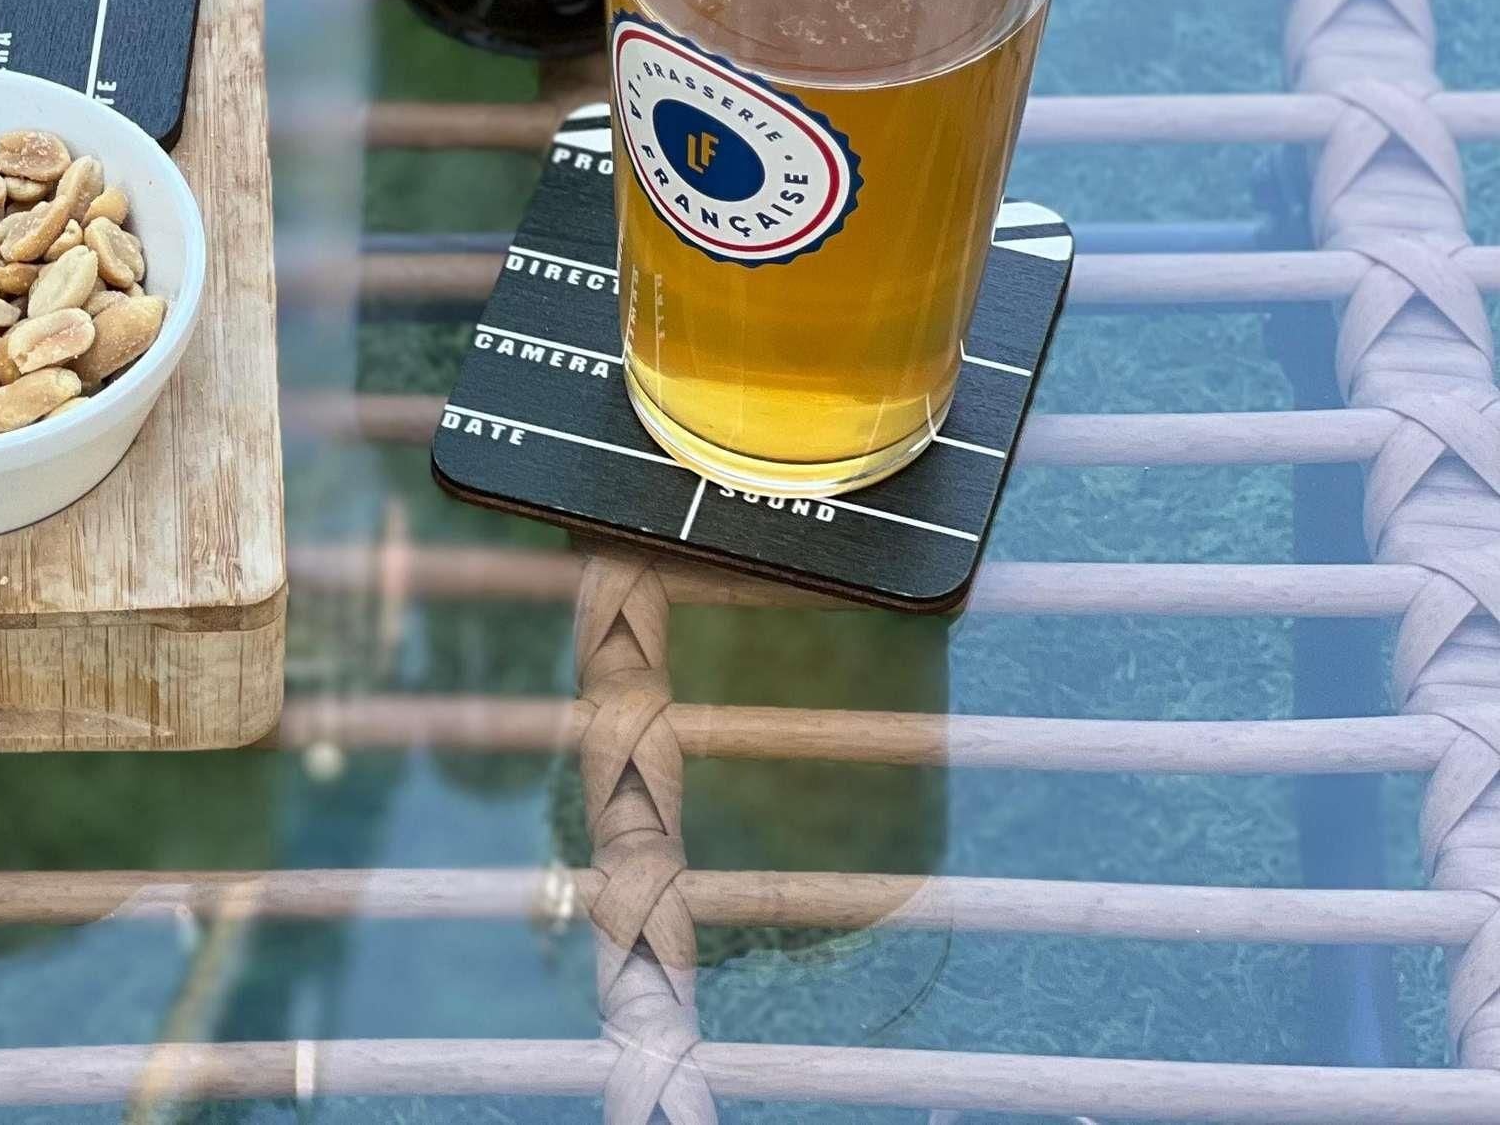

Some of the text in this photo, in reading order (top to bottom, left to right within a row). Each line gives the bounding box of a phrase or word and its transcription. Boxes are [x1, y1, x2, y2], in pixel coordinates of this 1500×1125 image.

[642, 61, 782, 143] BRASSERIE
[627, 79, 809, 238] LA FRANÇAISE
[686, 131, 719, 173] LF
[474, 333, 610, 379] CAMERA
[441, 412, 526, 446] DATE
[719, 486, 836, 523] SOUND
